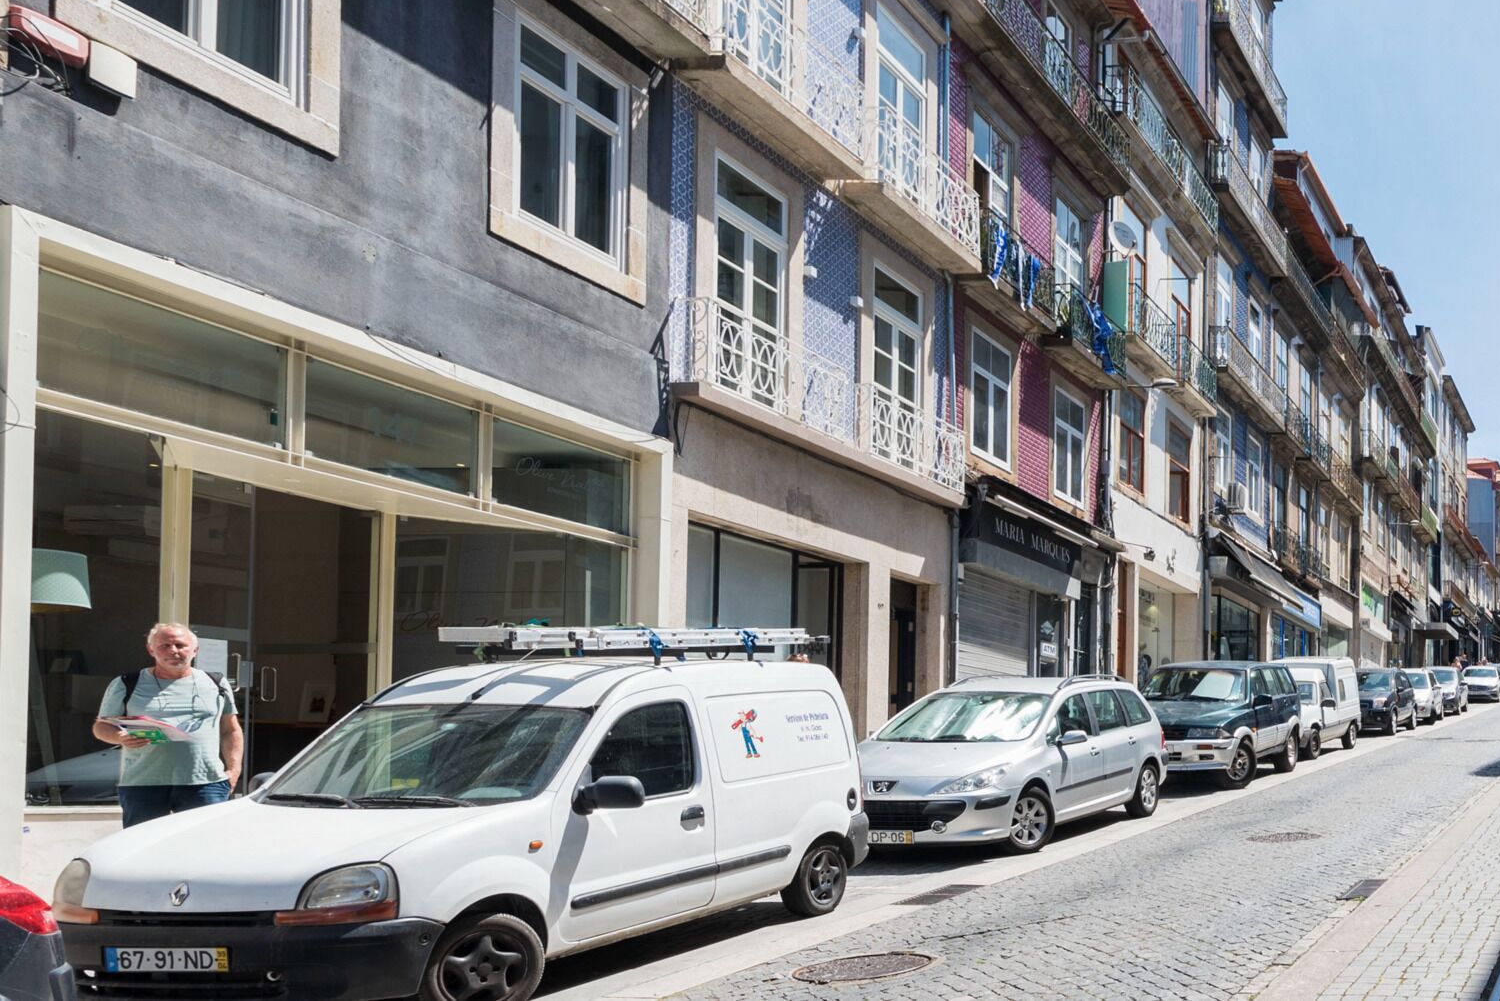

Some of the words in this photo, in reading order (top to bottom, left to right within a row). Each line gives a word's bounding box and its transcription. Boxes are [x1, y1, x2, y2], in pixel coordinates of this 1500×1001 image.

[995, 517, 1025, 545] MARIA
[1031, 532, 1071, 563] MARQUES
[1043, 645, 1056, 654] ATM
